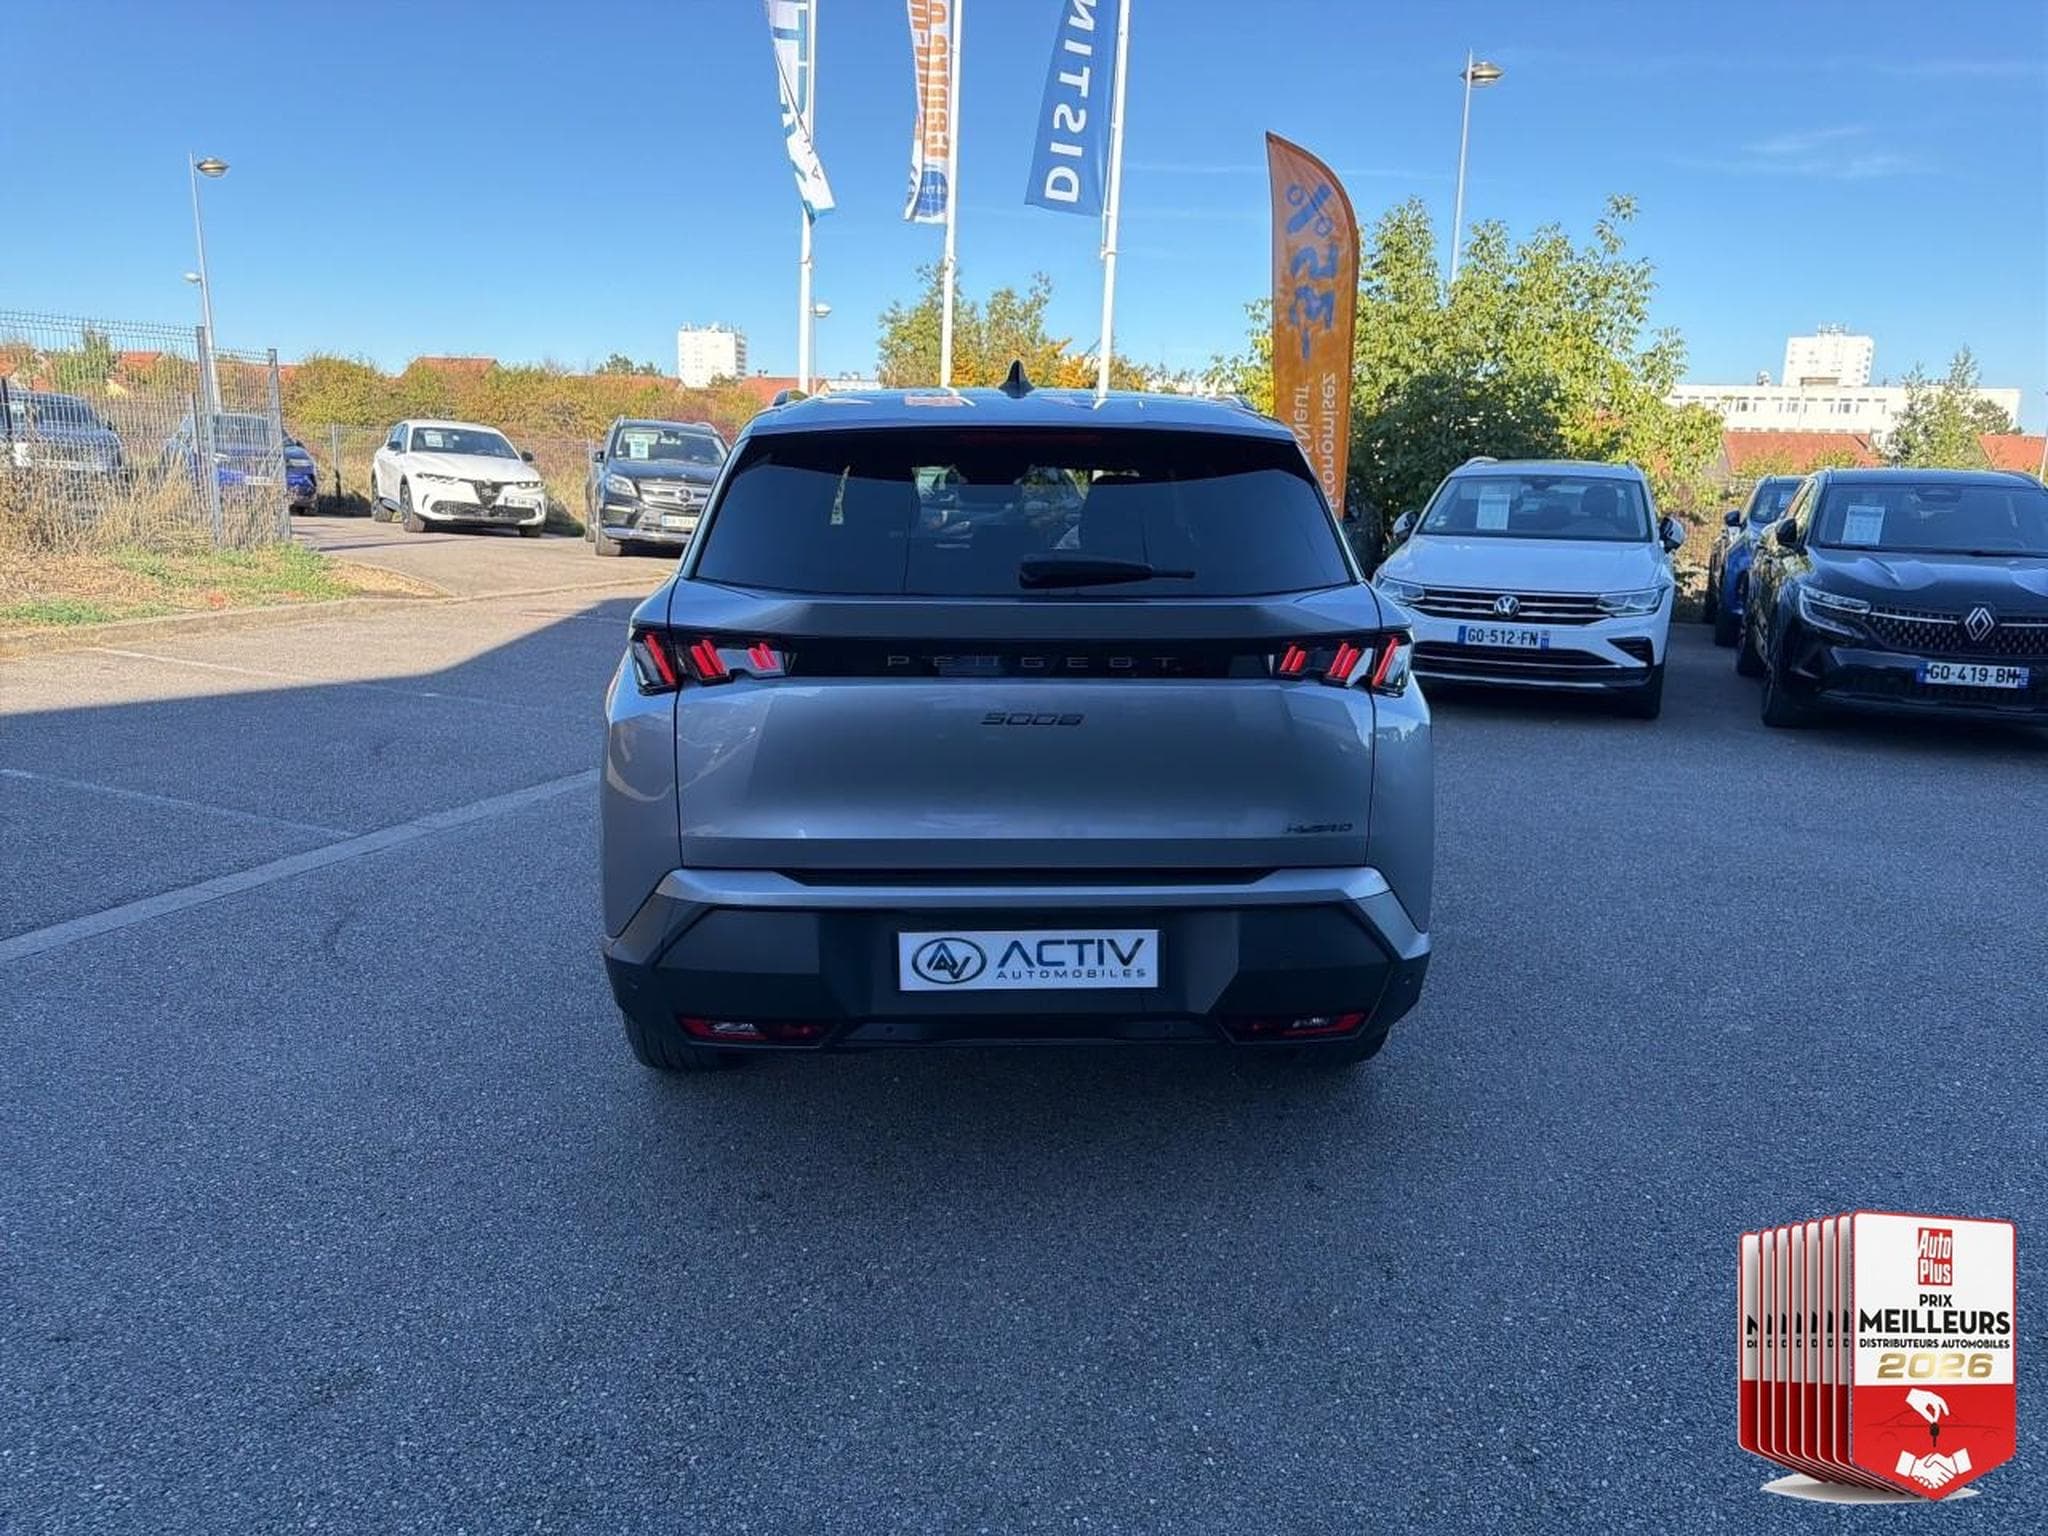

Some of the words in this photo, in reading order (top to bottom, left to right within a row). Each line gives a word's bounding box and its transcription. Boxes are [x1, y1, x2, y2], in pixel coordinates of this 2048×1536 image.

[980, 712, 1085, 727] 5008
[997, 938, 1145, 968] ACTIV
[996, 969, 1147, 980] AUTOMOBILES
